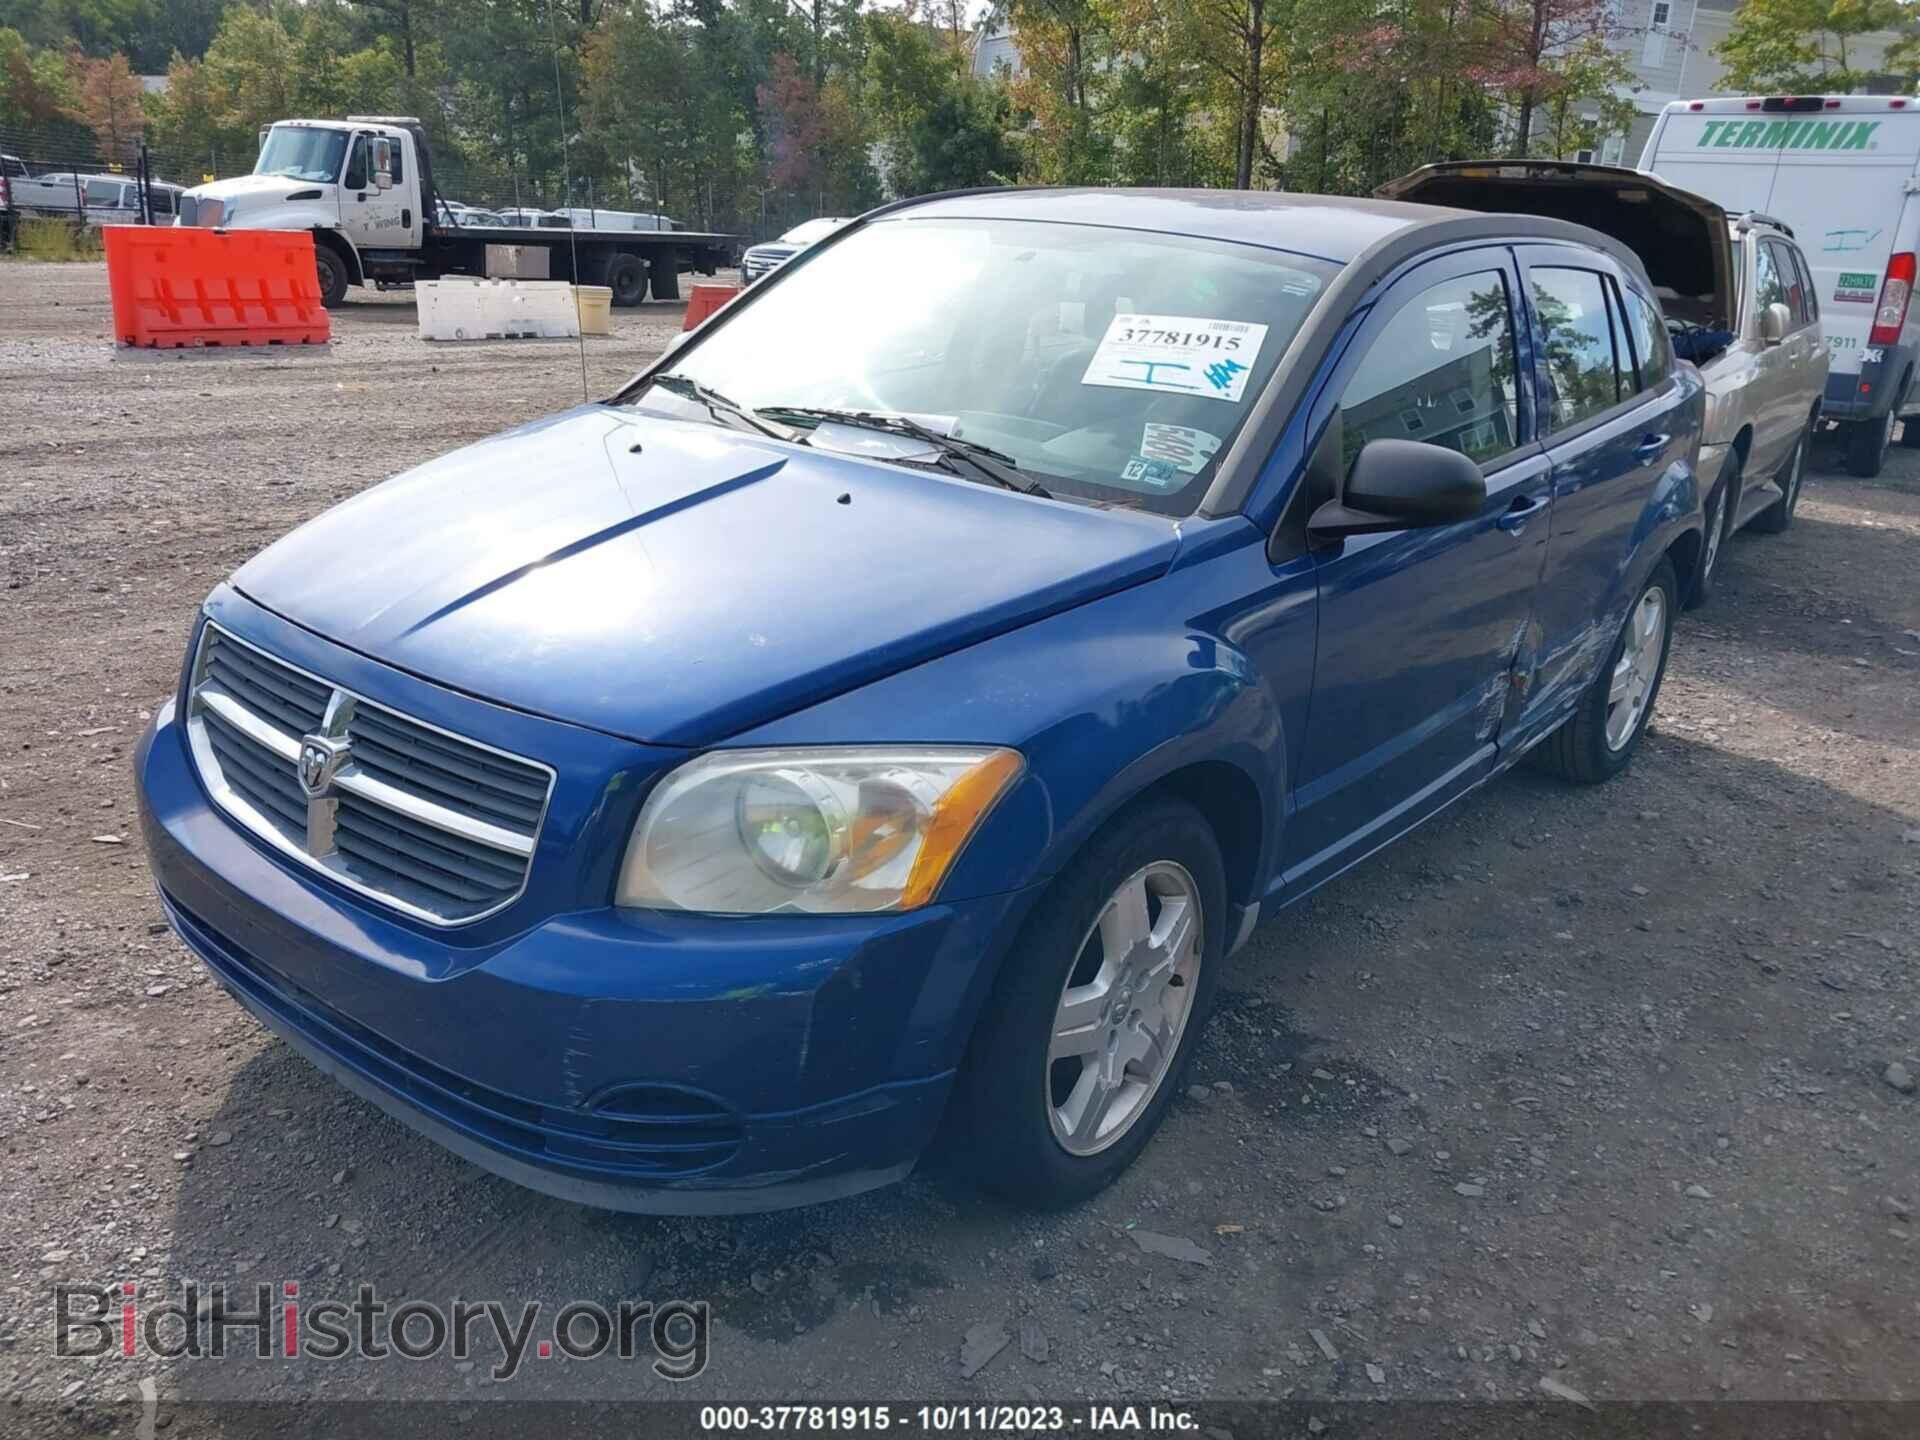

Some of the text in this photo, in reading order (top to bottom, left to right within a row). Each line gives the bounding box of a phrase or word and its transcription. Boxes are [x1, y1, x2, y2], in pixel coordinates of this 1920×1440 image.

[1697, 120, 1883, 150] TERMINIX
[1118, 328, 1242, 351] 37781915
[1127, 462, 1144, 478] 12
